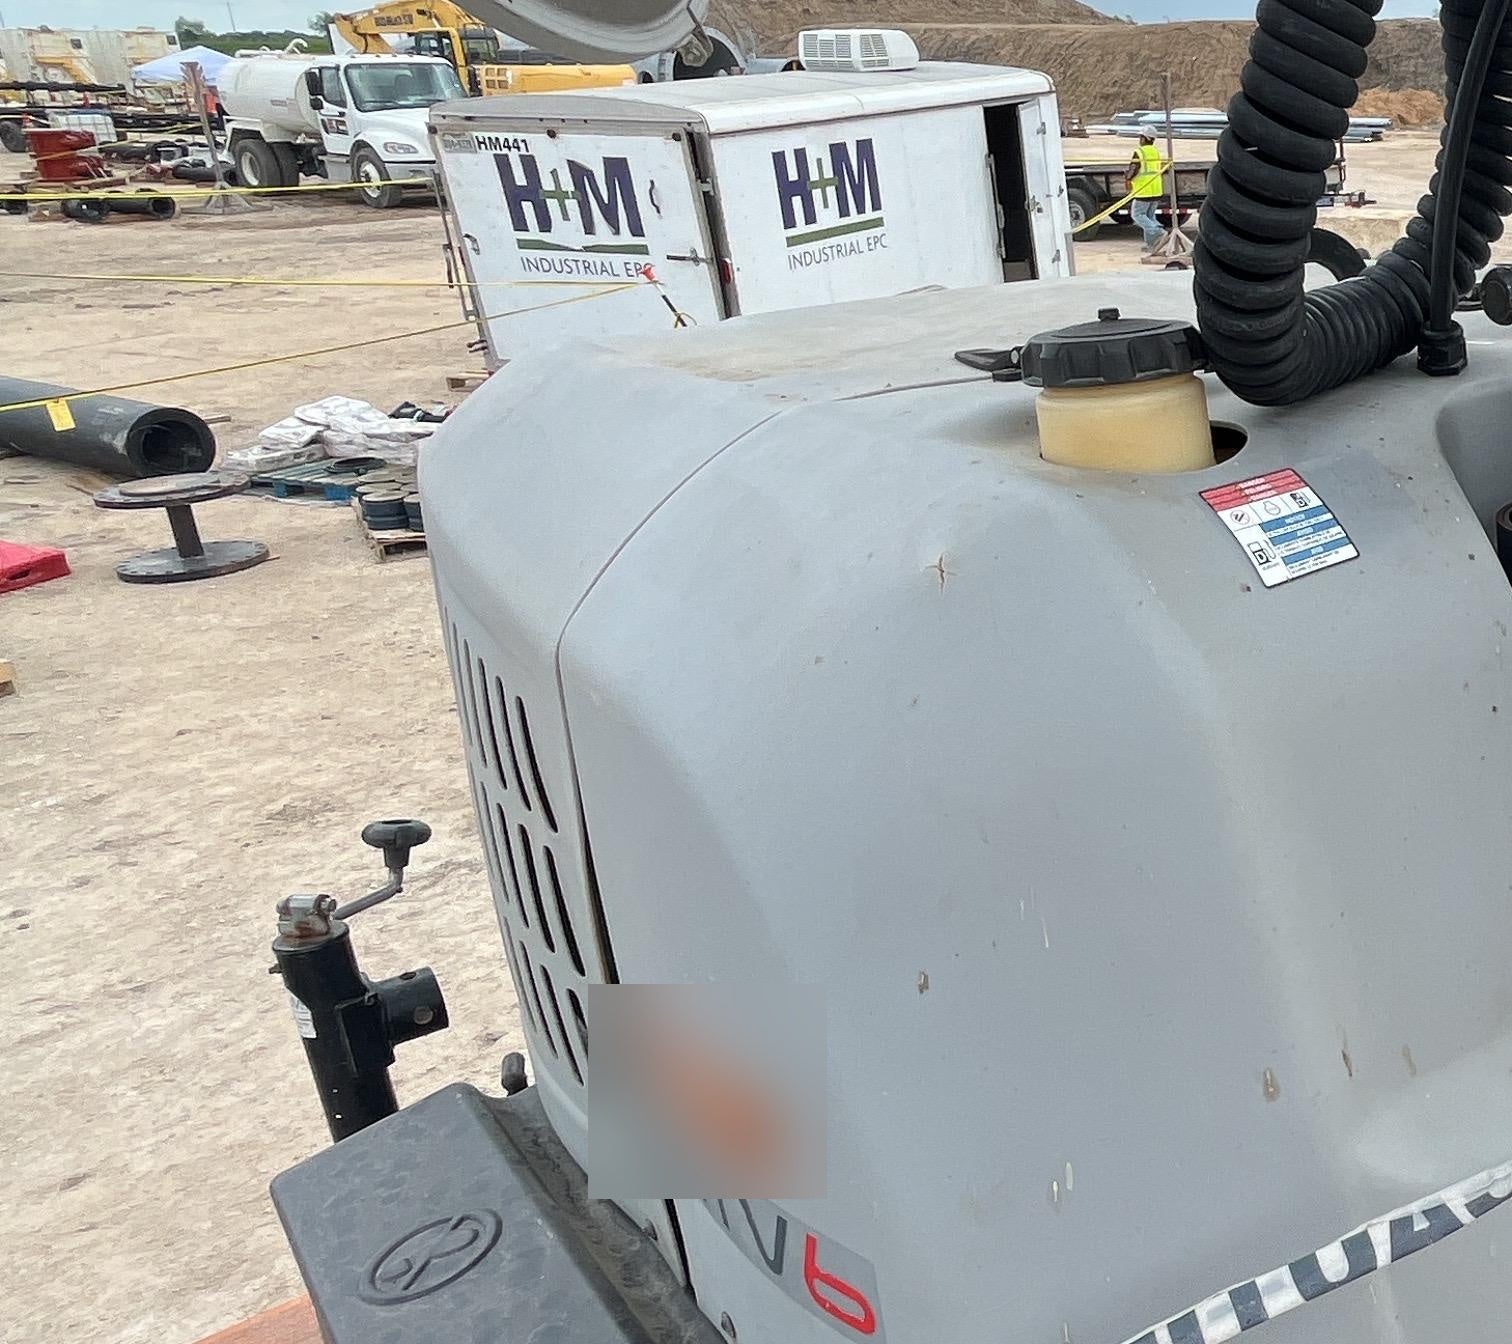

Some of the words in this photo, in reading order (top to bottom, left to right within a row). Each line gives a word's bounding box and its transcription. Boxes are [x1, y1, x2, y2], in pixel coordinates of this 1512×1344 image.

[475, 136, 530, 153] HM441
[788, 239, 864, 271] INDUSTRIAL
[867, 233, 888, 253] EPC
[520, 256, 620, 278] INDUSTRIAL
